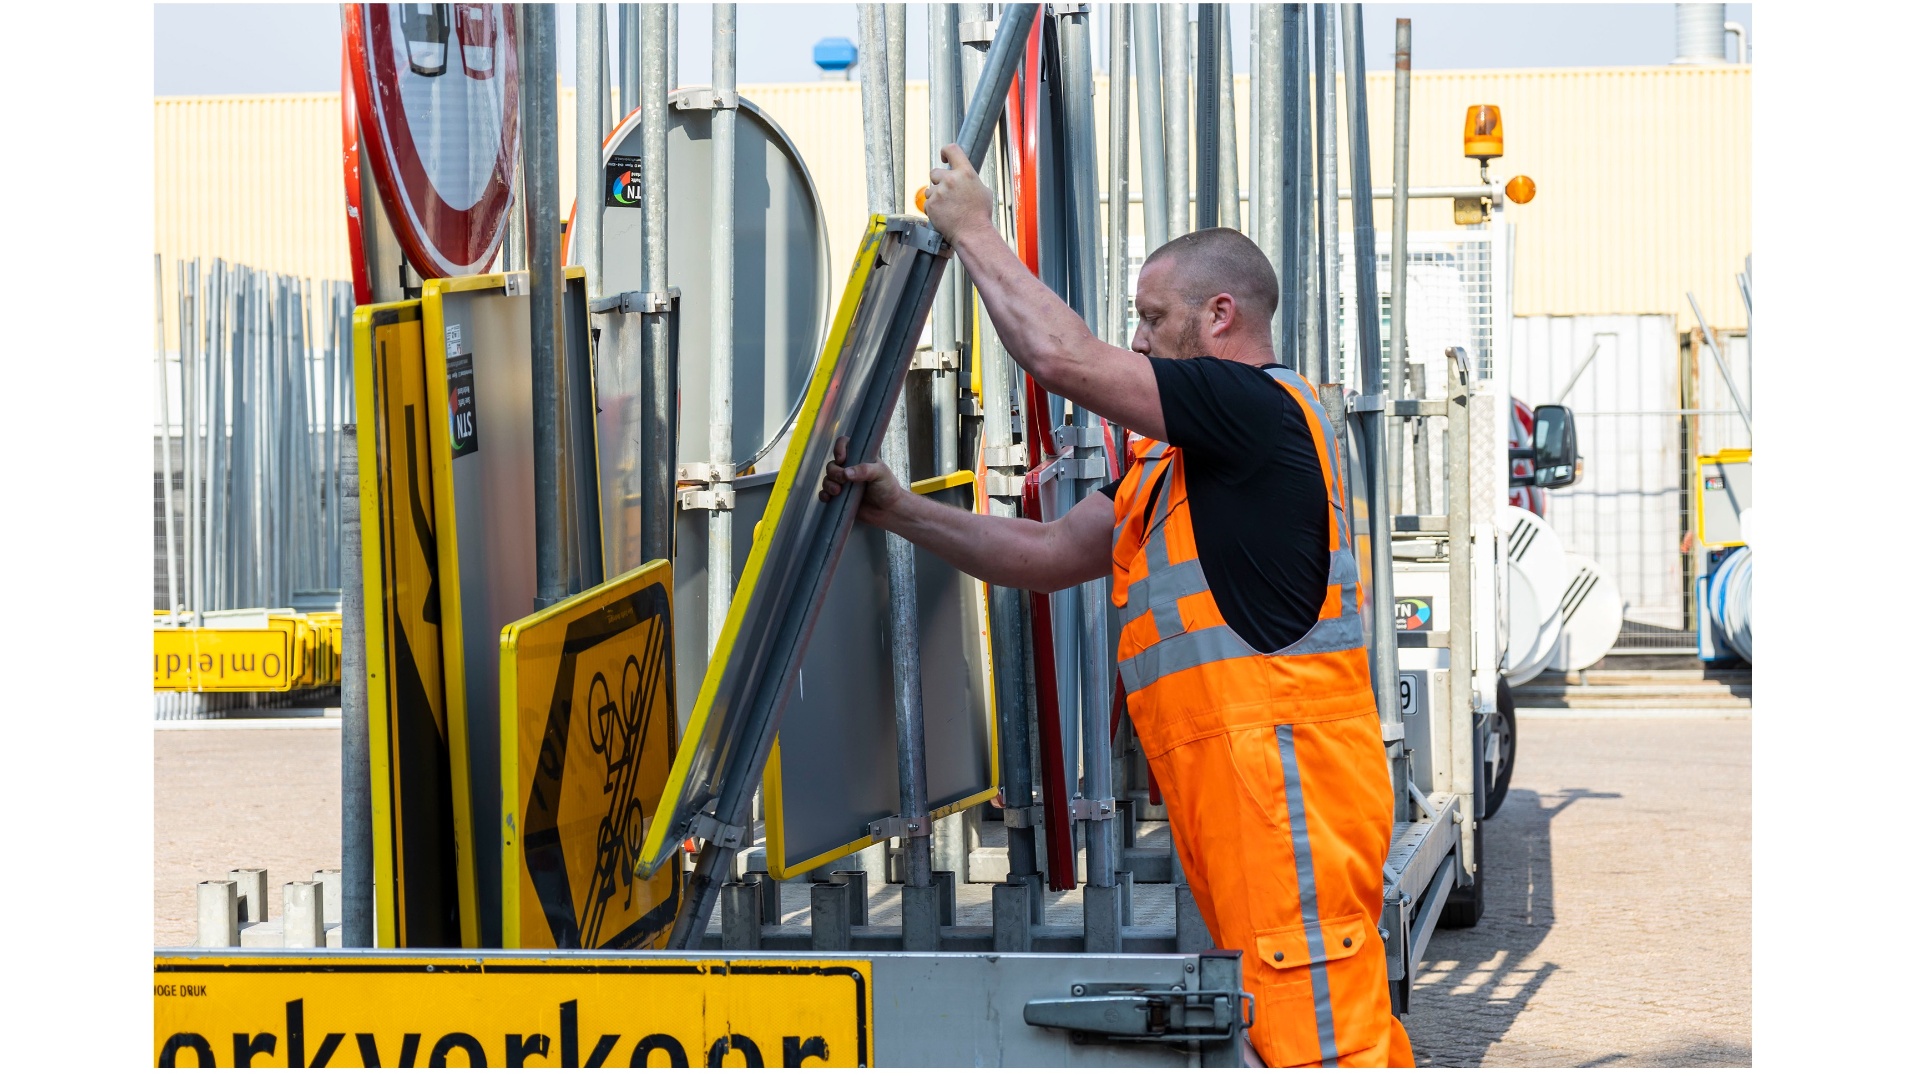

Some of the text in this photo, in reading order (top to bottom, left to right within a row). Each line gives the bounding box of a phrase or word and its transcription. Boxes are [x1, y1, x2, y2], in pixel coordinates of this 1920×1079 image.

[627, 185, 641, 200] TN
[456, 411, 472, 439] STN
[1395, 603, 1412, 618] TN
[154, 653, 281, 679] Omleidi
[1400, 680, 1411, 710] 9
[180, 984, 207, 997] DRUK
